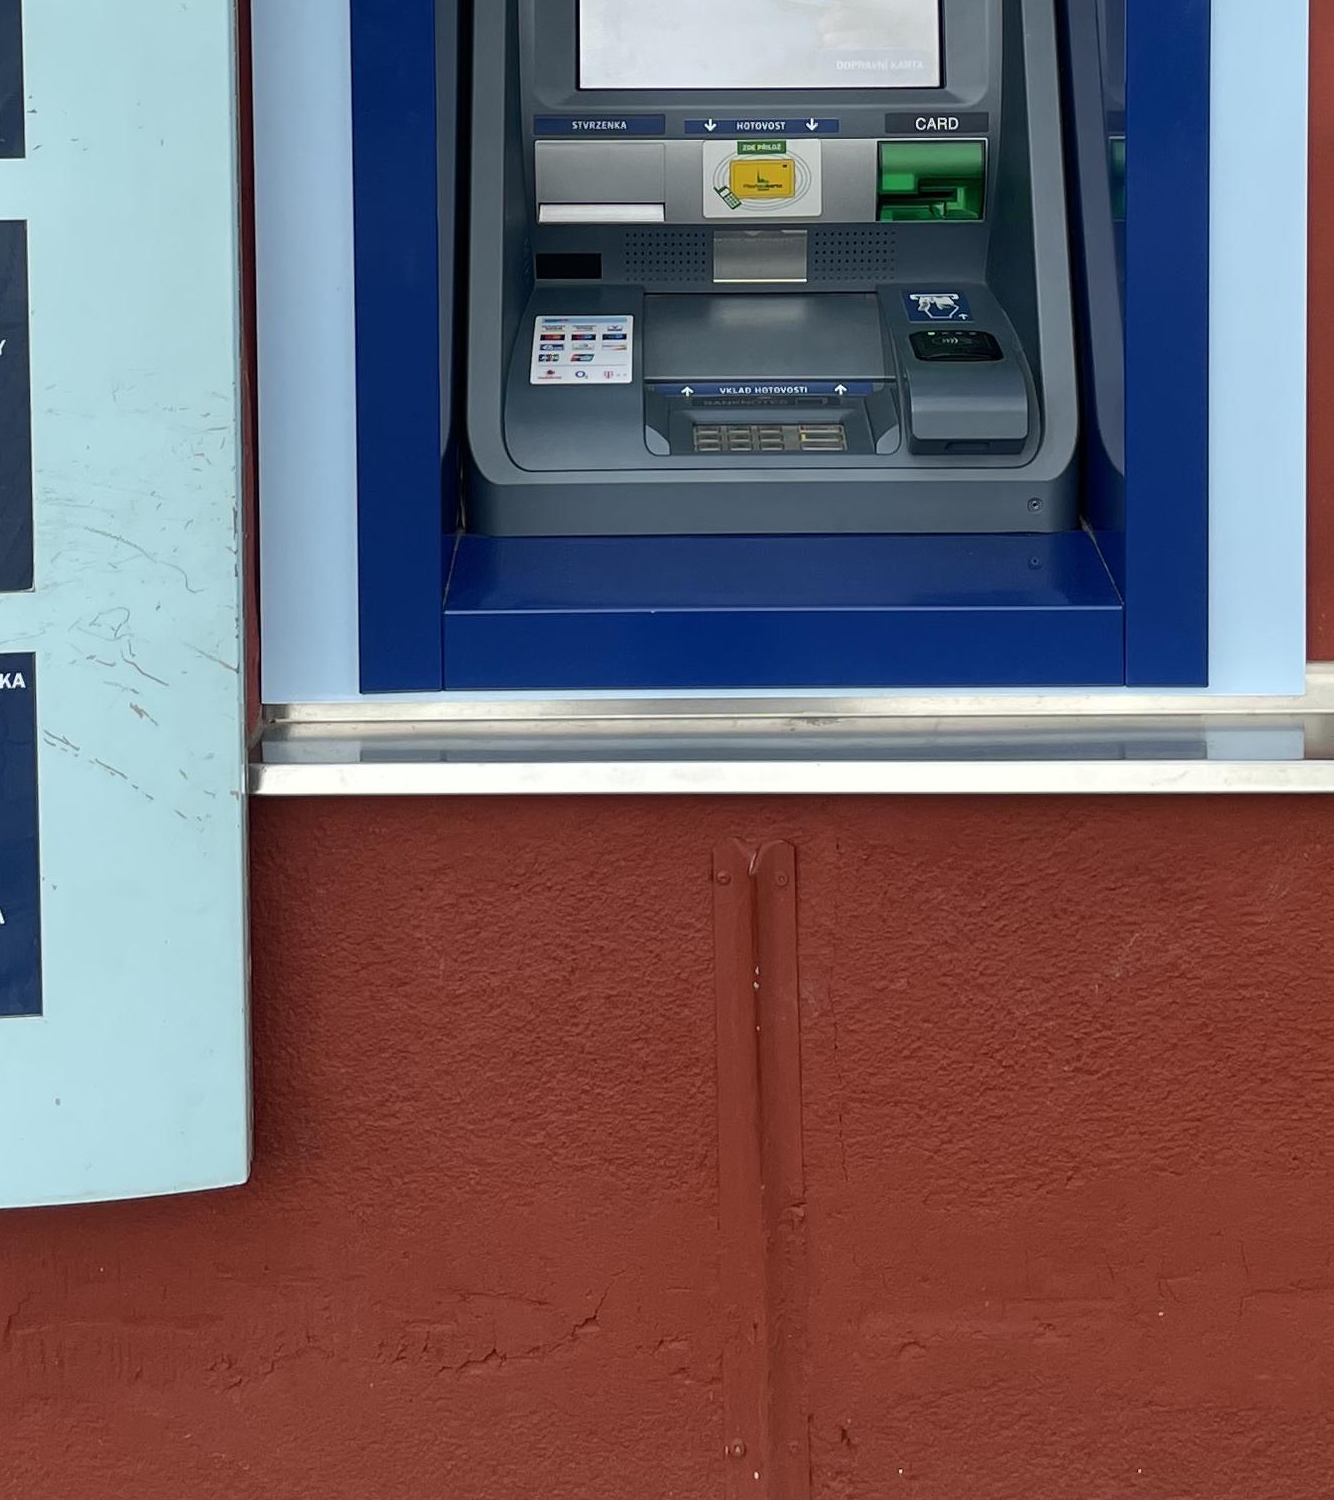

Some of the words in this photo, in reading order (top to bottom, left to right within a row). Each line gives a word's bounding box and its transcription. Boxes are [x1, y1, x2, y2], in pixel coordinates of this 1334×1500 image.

[571, 120, 627, 130] STVRZENKA
[736, 120, 786, 131] HOTOVOST
[915, 116, 959, 131] CARD
[755, 386, 808, 394] HOTOVOSTI
